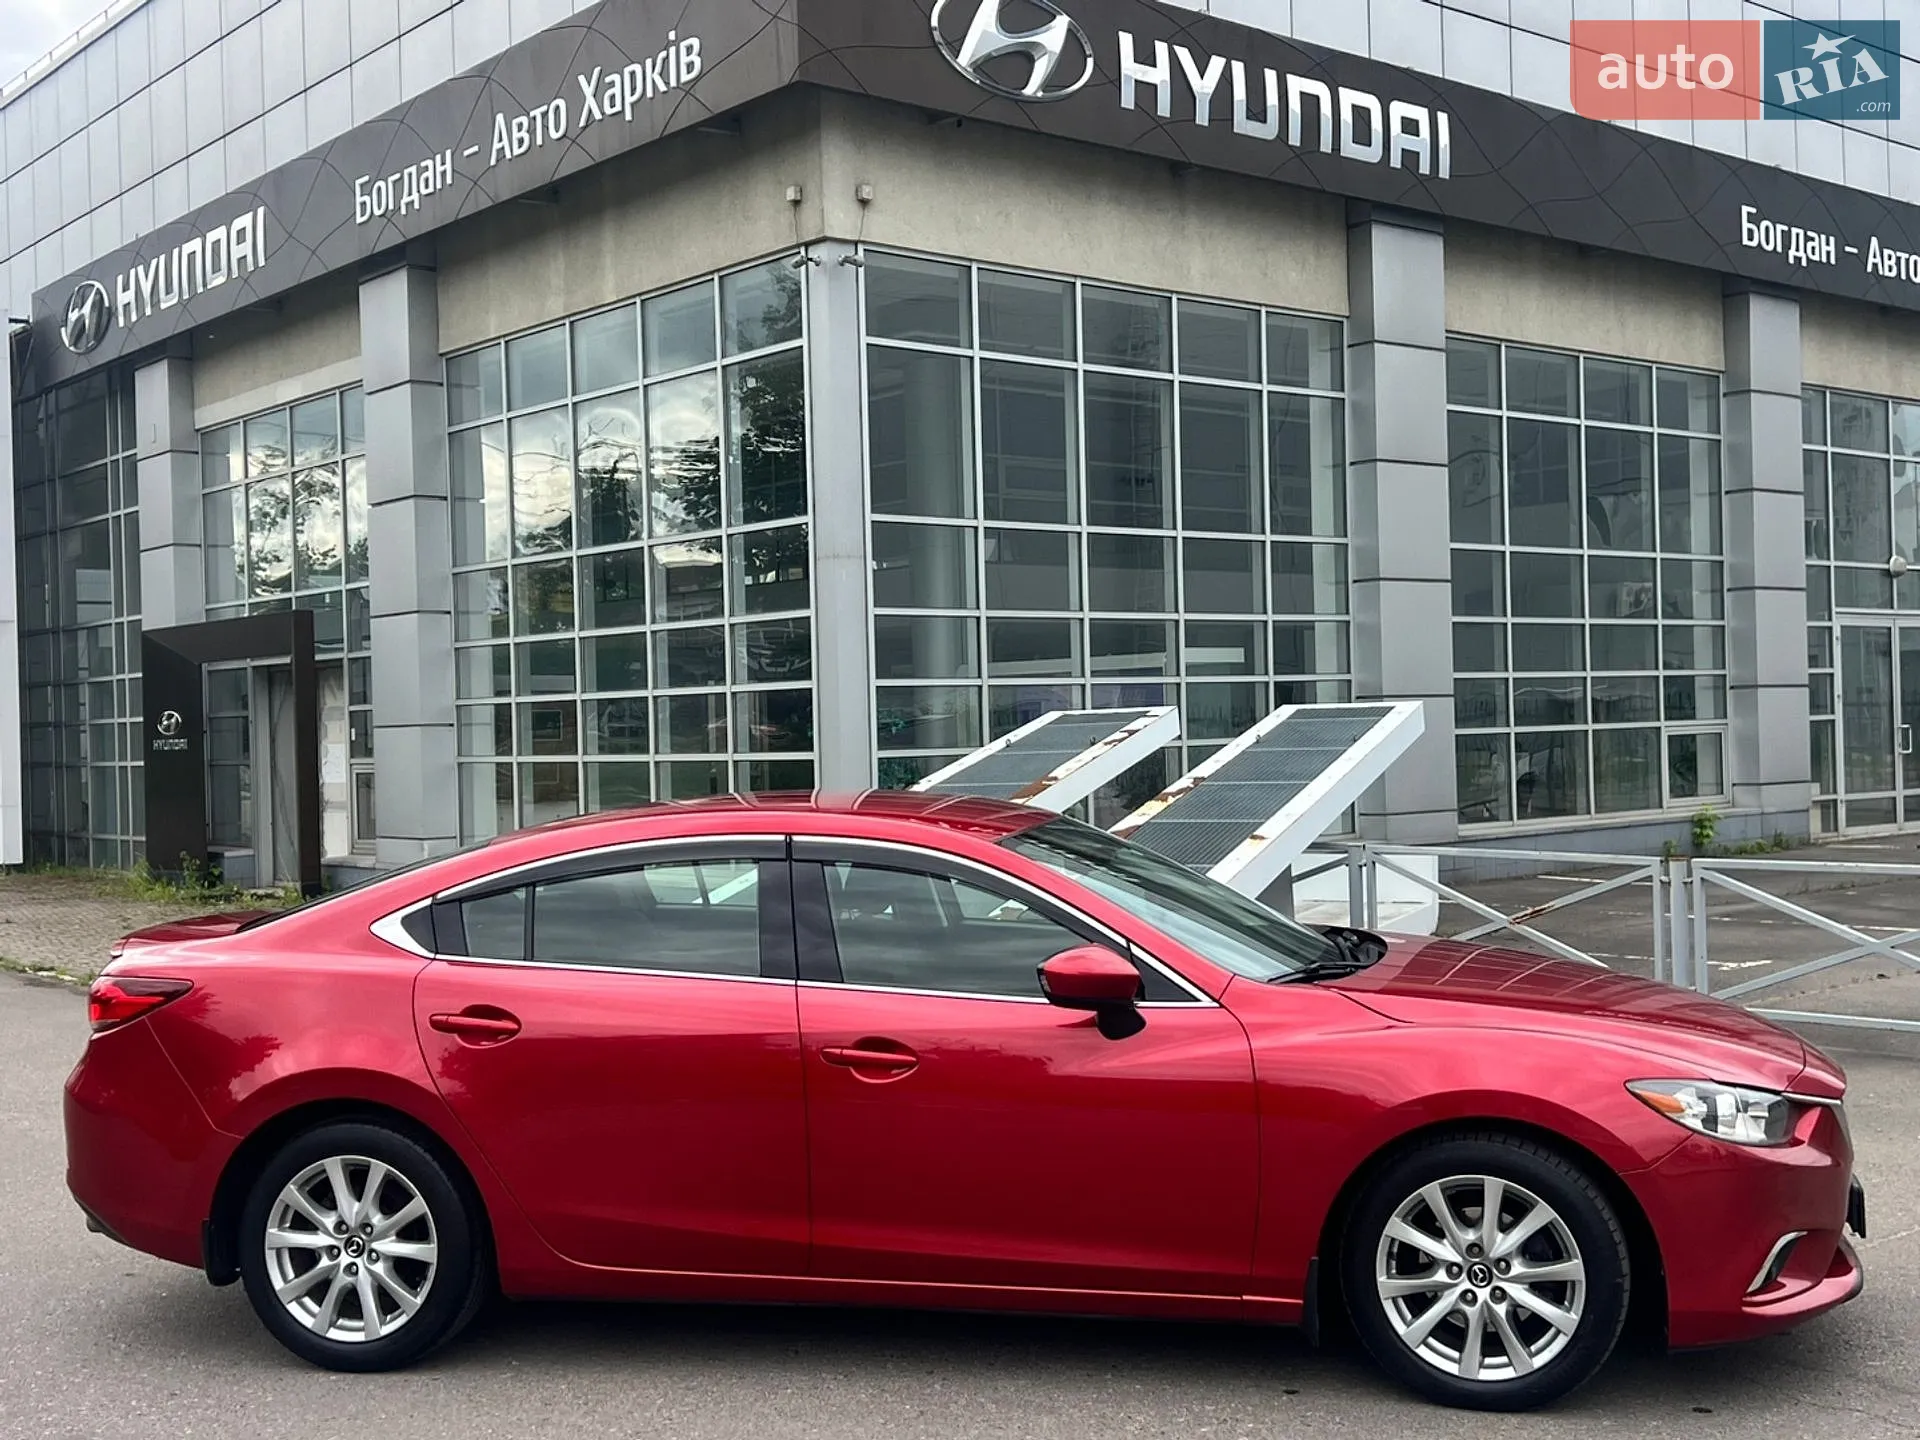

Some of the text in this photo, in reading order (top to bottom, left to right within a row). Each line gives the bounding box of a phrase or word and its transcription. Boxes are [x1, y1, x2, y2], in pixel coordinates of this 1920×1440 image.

[354, 148, 453, 224] Богдан
[490, 97, 567, 166] Авто
[577, 30, 702, 128] Харків
[1118, 31, 1450, 179] HYUNDAI
[116, 206, 266, 328] HYUNDAI
[1741, 205, 1836, 267] Богдан
[153, 739, 188, 750] HYUNDAI
